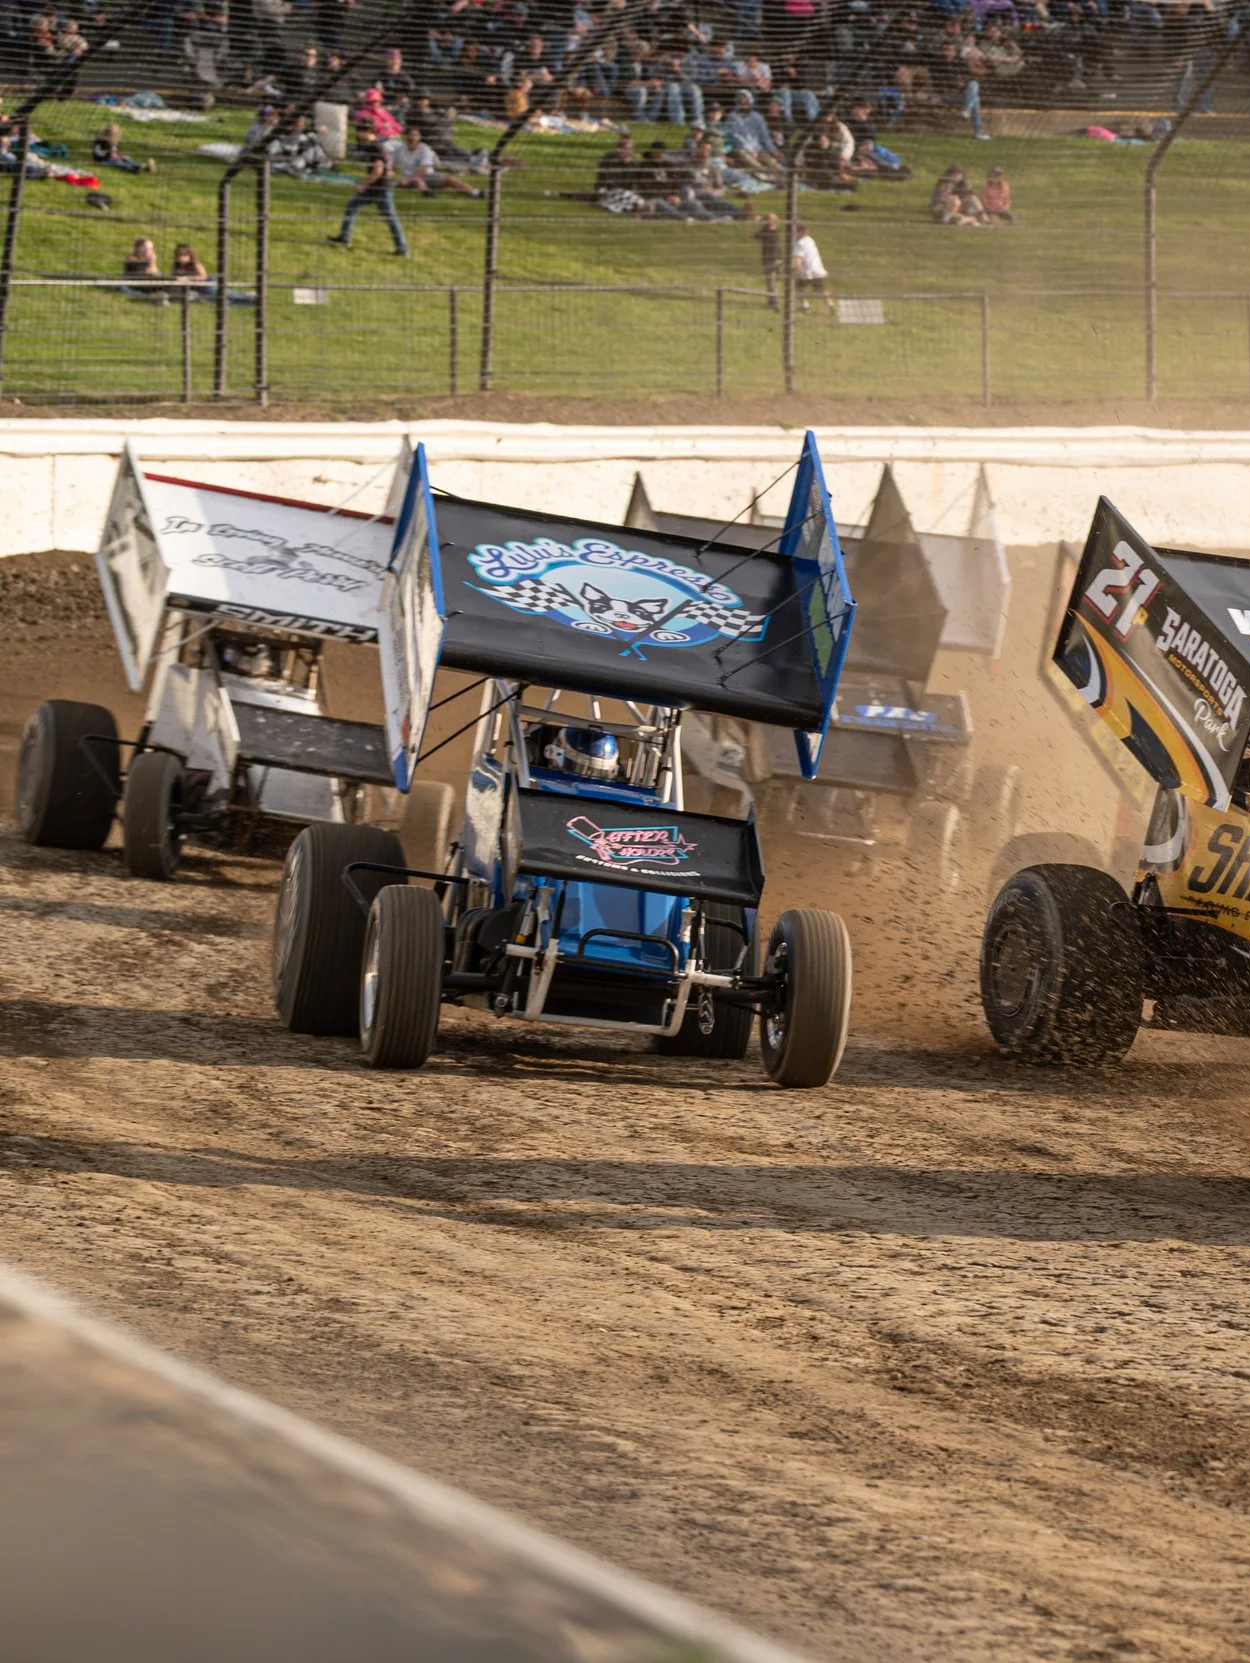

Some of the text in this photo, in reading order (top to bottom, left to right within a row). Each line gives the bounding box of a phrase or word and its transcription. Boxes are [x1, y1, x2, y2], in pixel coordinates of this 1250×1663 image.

[578, 542, 731, 601] Espresso
[211, 603, 378, 642] SMITH
[1155, 606, 1247, 731] SARATOGA
[1168, 653, 1223, 717] MOTORSPORTS
[1194, 698, 1229, 752] Park
[606, 829, 669, 843] AFTER
